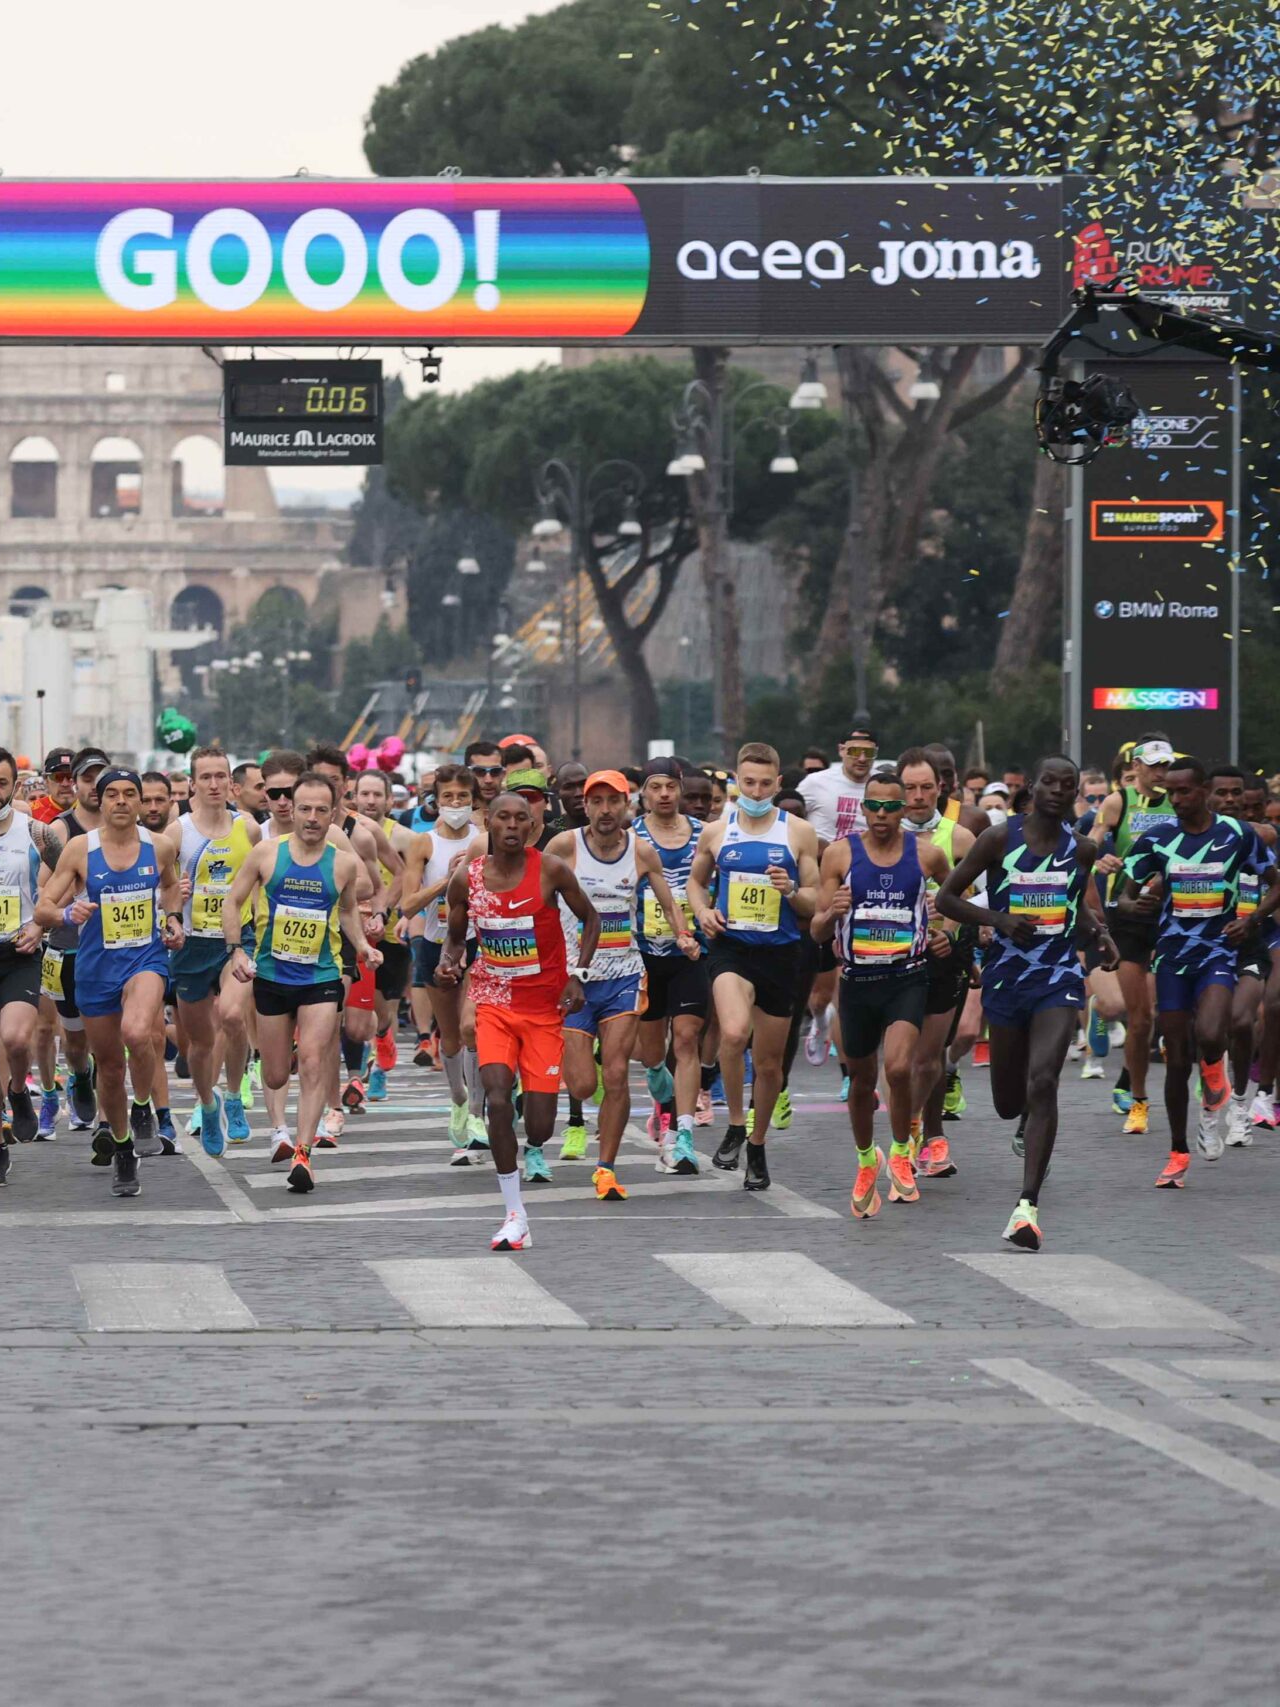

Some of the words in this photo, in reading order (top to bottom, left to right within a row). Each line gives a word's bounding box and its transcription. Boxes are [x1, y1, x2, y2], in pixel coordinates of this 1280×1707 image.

[95, 207, 501, 312] GOOO!
[676, 240, 846, 280] acea
[1125, 241, 1187, 263] RUN
[1137, 265, 1215, 286] ROME
[230, 431, 291, 447] MAURICE
[317, 431, 376, 447] LACROIX
[1118, 602, 1165, 618] BMW
[1169, 602, 1219, 618] Roma
[1105, 691, 1206, 707] MASSIGEN
[118, 882, 147, 892] UNION
[283, 885, 322, 893] PARATICO
[284, 877, 323, 887] ATLETICA
[741, 888, 766, 905] 481
[866, 889, 886, 900] irish
[887, 890, 905, 901] pub
[112, 903, 145, 922] 3415
[202, 920, 208, 929] 2
[283, 920, 317, 939] 6763
[115, 931, 121, 939] 5
[132, 928, 143, 937] TOP
[280, 943, 290, 952] 10
[485, 936, 530, 958] PACER
